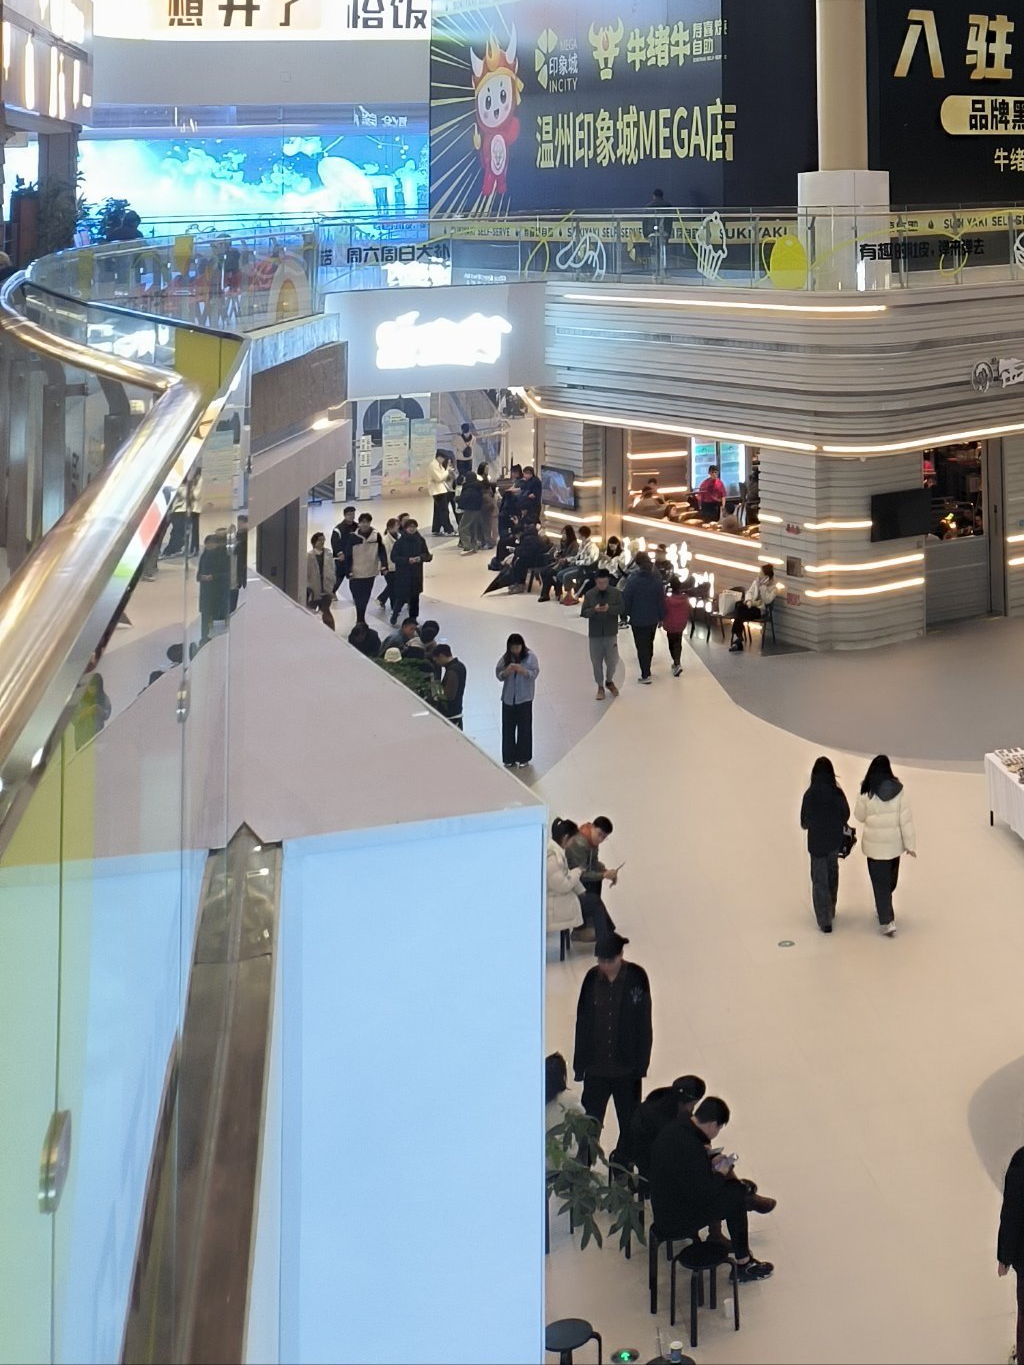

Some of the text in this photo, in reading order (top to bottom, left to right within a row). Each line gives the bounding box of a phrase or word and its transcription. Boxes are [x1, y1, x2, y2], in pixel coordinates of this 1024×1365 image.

[560, 37, 578, 51] MEGA
[692, 38, 714, 56] 自助
[549, 53, 579, 75] 印象城
[549, 77, 578, 93] INCITY
[535, 97, 737, 169] 温州印象城MEGA店
